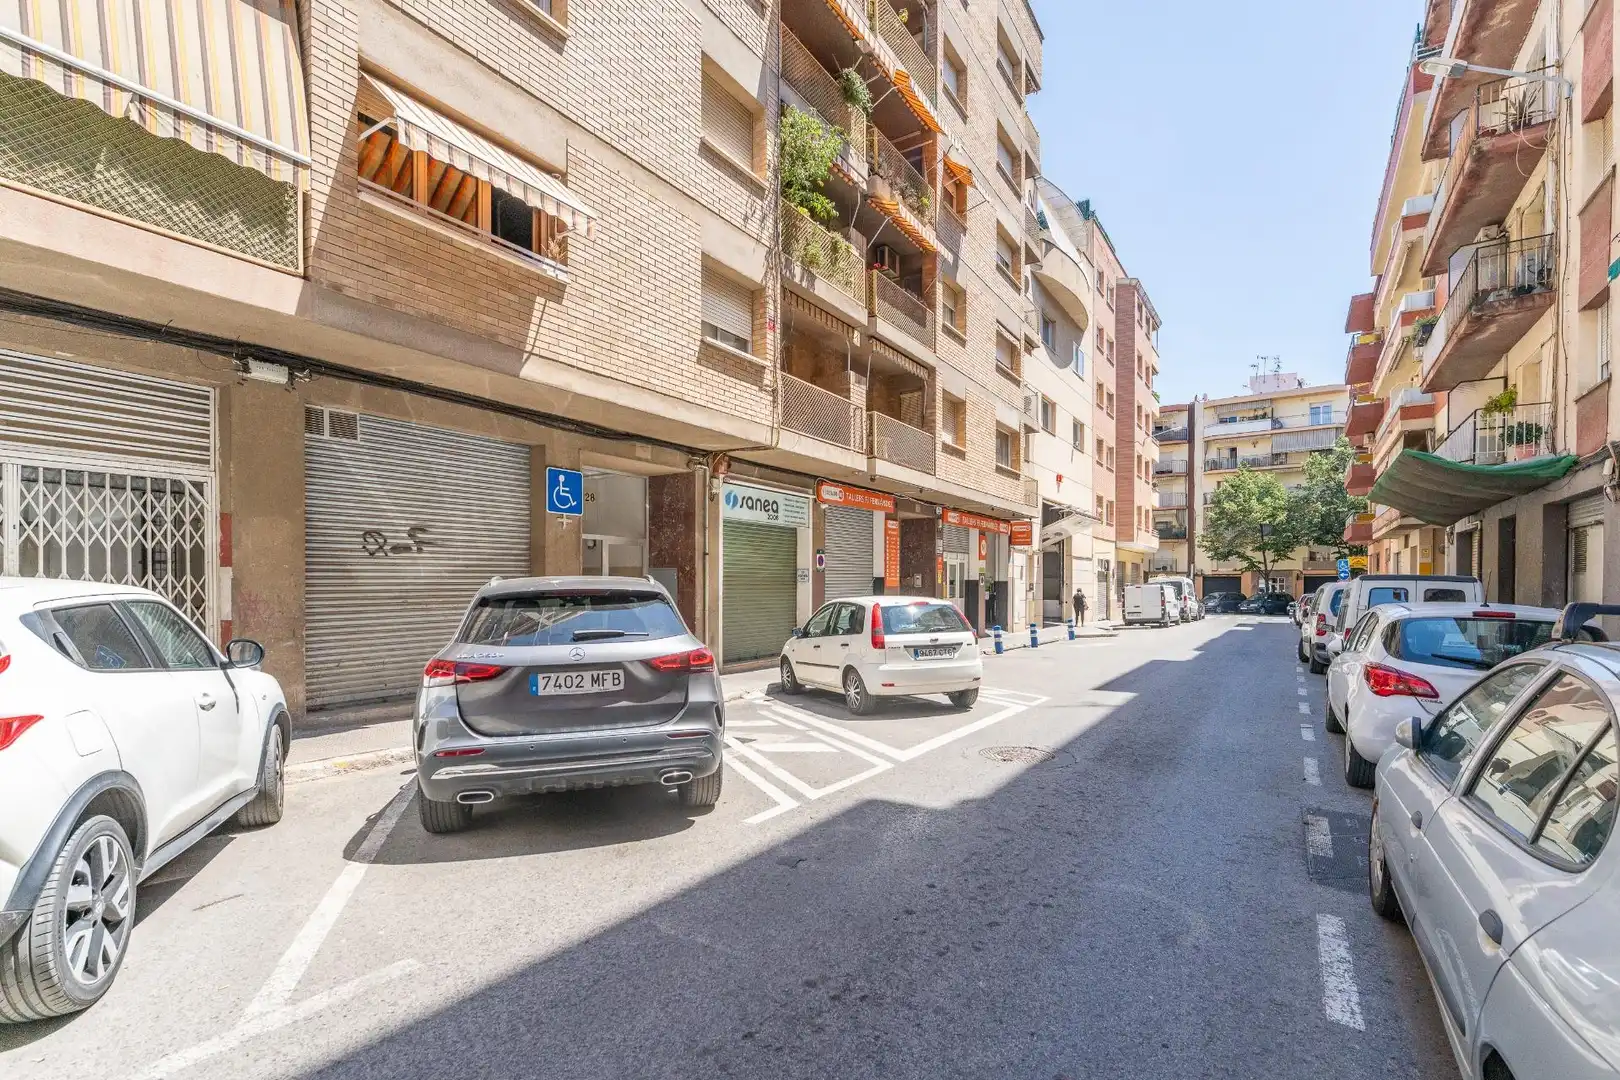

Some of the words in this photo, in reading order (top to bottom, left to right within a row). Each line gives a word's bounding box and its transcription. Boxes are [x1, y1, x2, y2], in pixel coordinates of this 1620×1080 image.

[584, 492, 595, 502] 28
[739, 495, 779, 514] sanea
[846, 492, 865, 504] TALLERS
[541, 674, 584, 691] 7402
[590, 672, 621, 688] MFB
